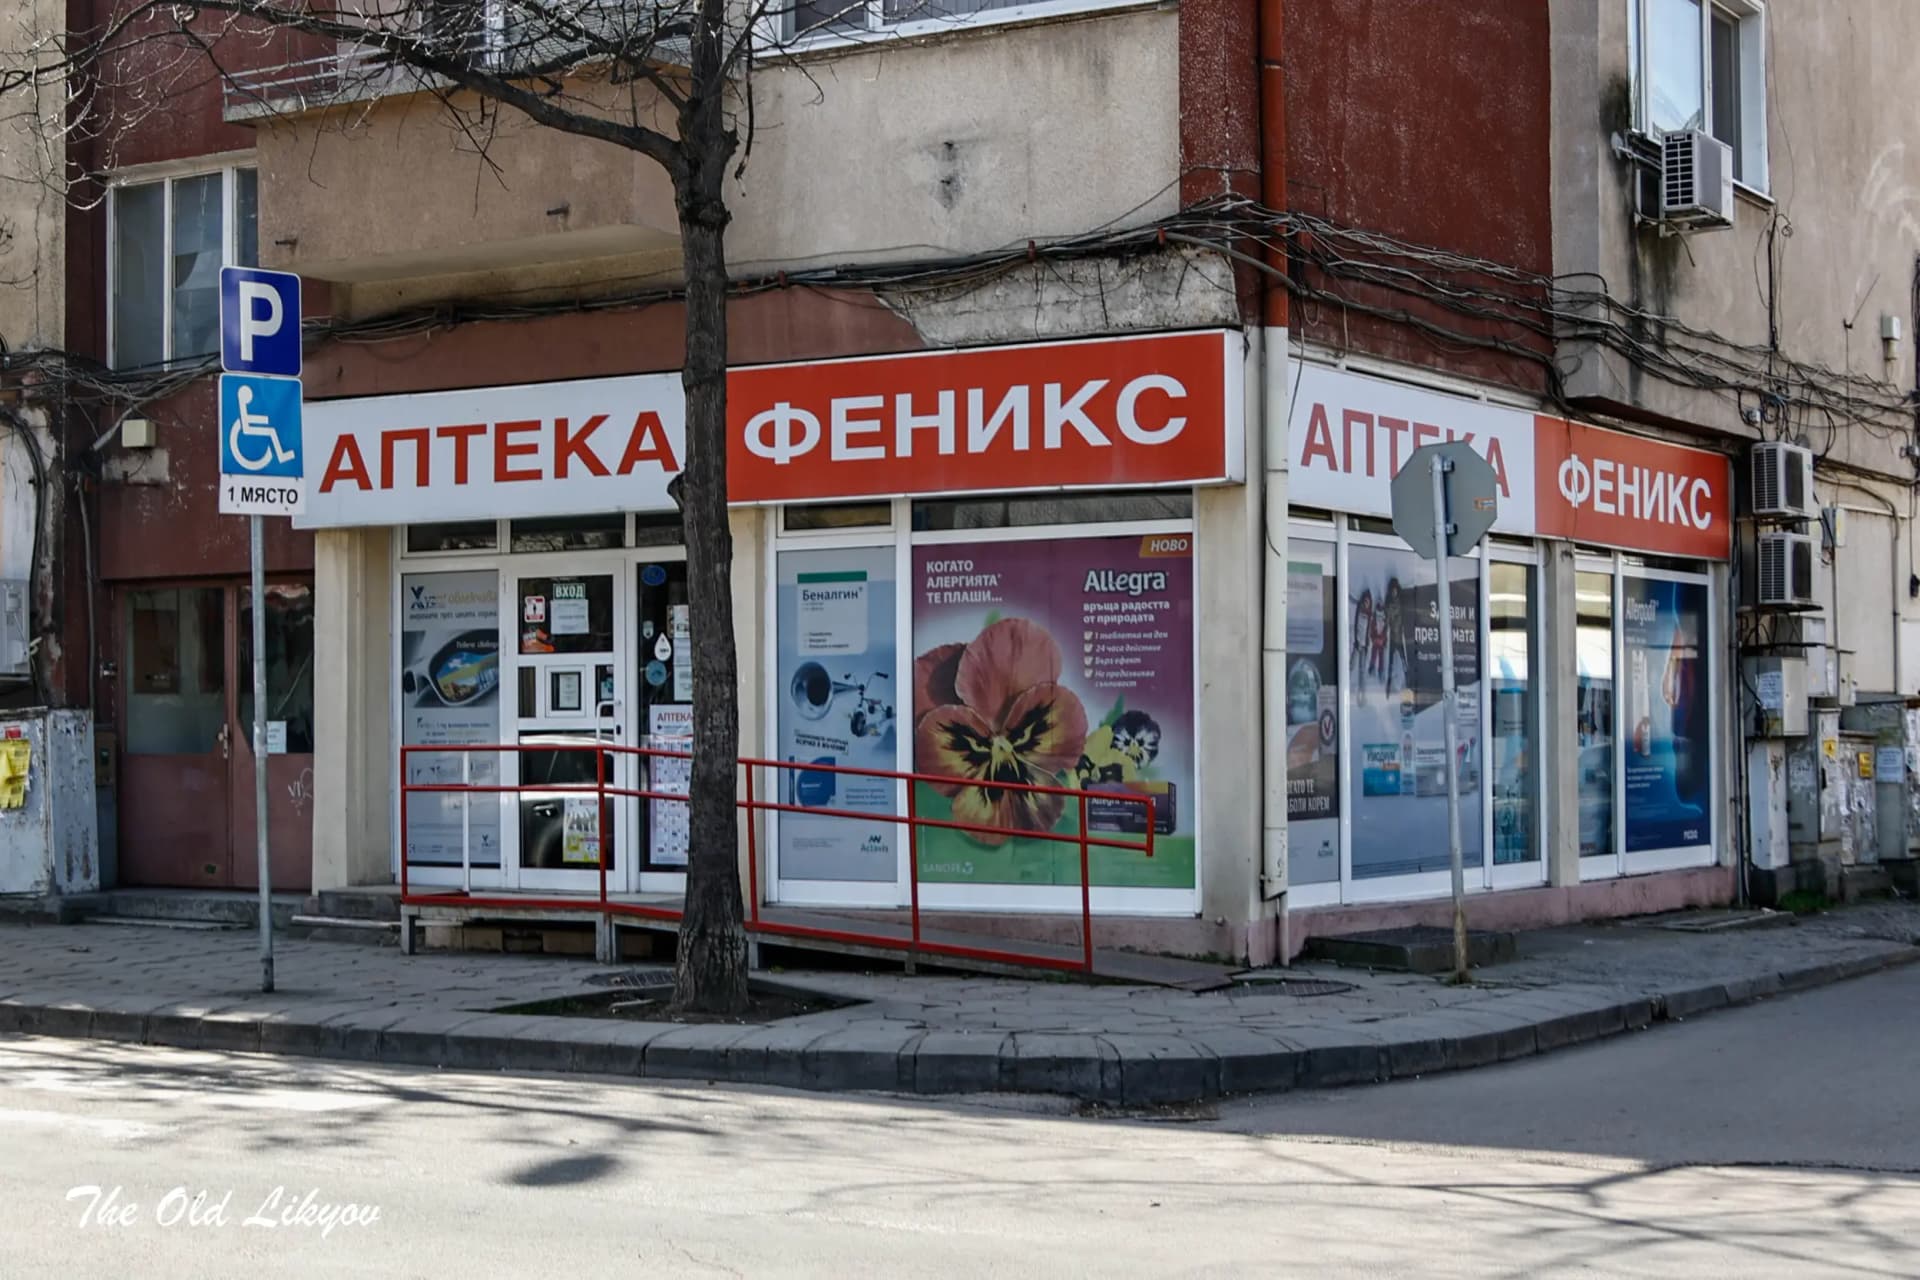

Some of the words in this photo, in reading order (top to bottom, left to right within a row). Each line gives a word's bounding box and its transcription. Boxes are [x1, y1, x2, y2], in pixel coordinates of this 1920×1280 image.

[239, 281, 283, 361] P
[318, 411, 680, 493] АПТЕКА
[743, 374, 1188, 465] ФЕНИКС
[1301, 402, 1511, 499] АПТА
[1557, 453, 1712, 531] ФЕНИКС
[228, 486, 235, 502] 1
[241, 486, 299, 505] МЯСТО
[1150, 539, 1188, 552] НОВО
[926, 560, 974, 573] КОГАТО
[555, 584, 584, 598] ВХОД
[1084, 570, 1167, 596] Allegra
[926, 592, 941, 604] ТЕ
[1083, 602, 1120, 613] връща
[1121, 601, 1170, 613] радостта
[1083, 615, 1095, 624] от
[1097, 613, 1155, 625] природата
[1430, 601, 1466, 621] Зави
[1415, 627, 1439, 645] през
